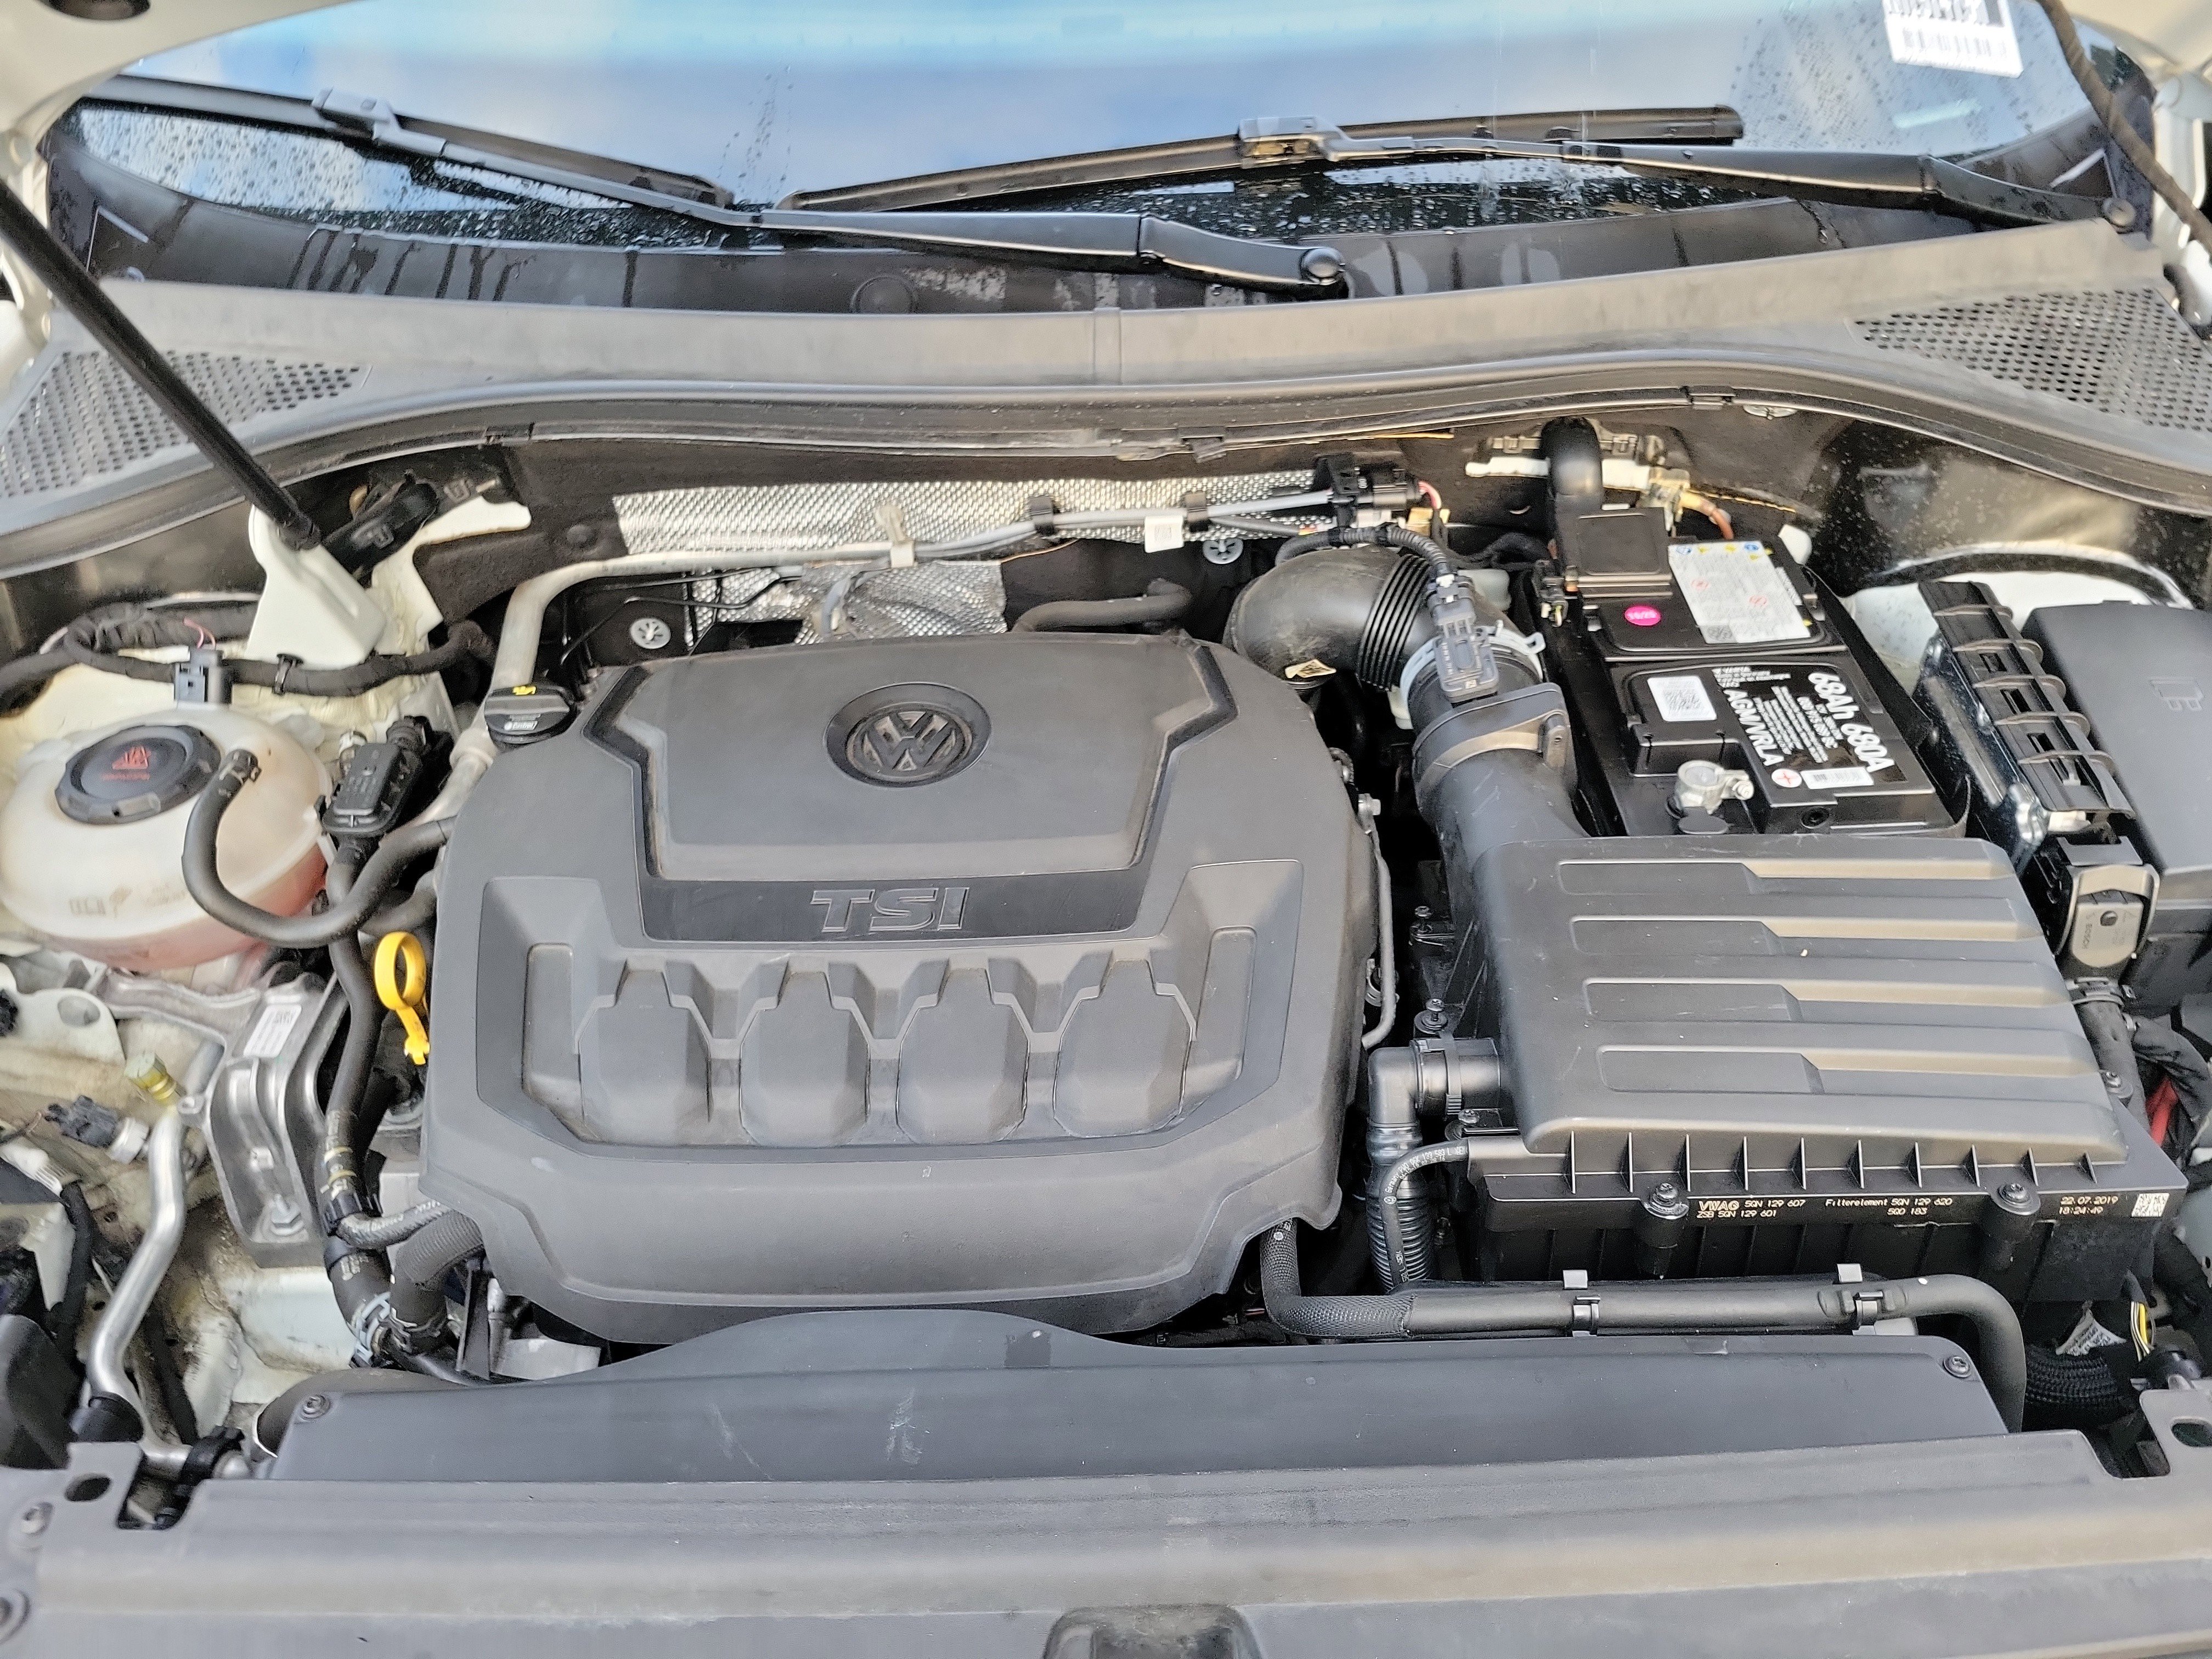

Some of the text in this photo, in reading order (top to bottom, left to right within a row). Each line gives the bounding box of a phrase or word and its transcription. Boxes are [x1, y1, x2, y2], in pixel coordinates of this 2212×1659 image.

[1808, 672, 1859, 720] 68Ah
[1841, 723, 1894, 773] 680A
[810, 887, 970, 933] TSI
[1698, 1200, 1740, 1211] VWAG
[1768, 1199, 1784, 1207] 129
[1825, 1198, 1887, 1207] Filterelement
[1914, 1198, 1931, 1206] 129
[1933, 1198, 1953, 1206] 620
[2060, 1195, 2119, 1205] 22.07.2019
